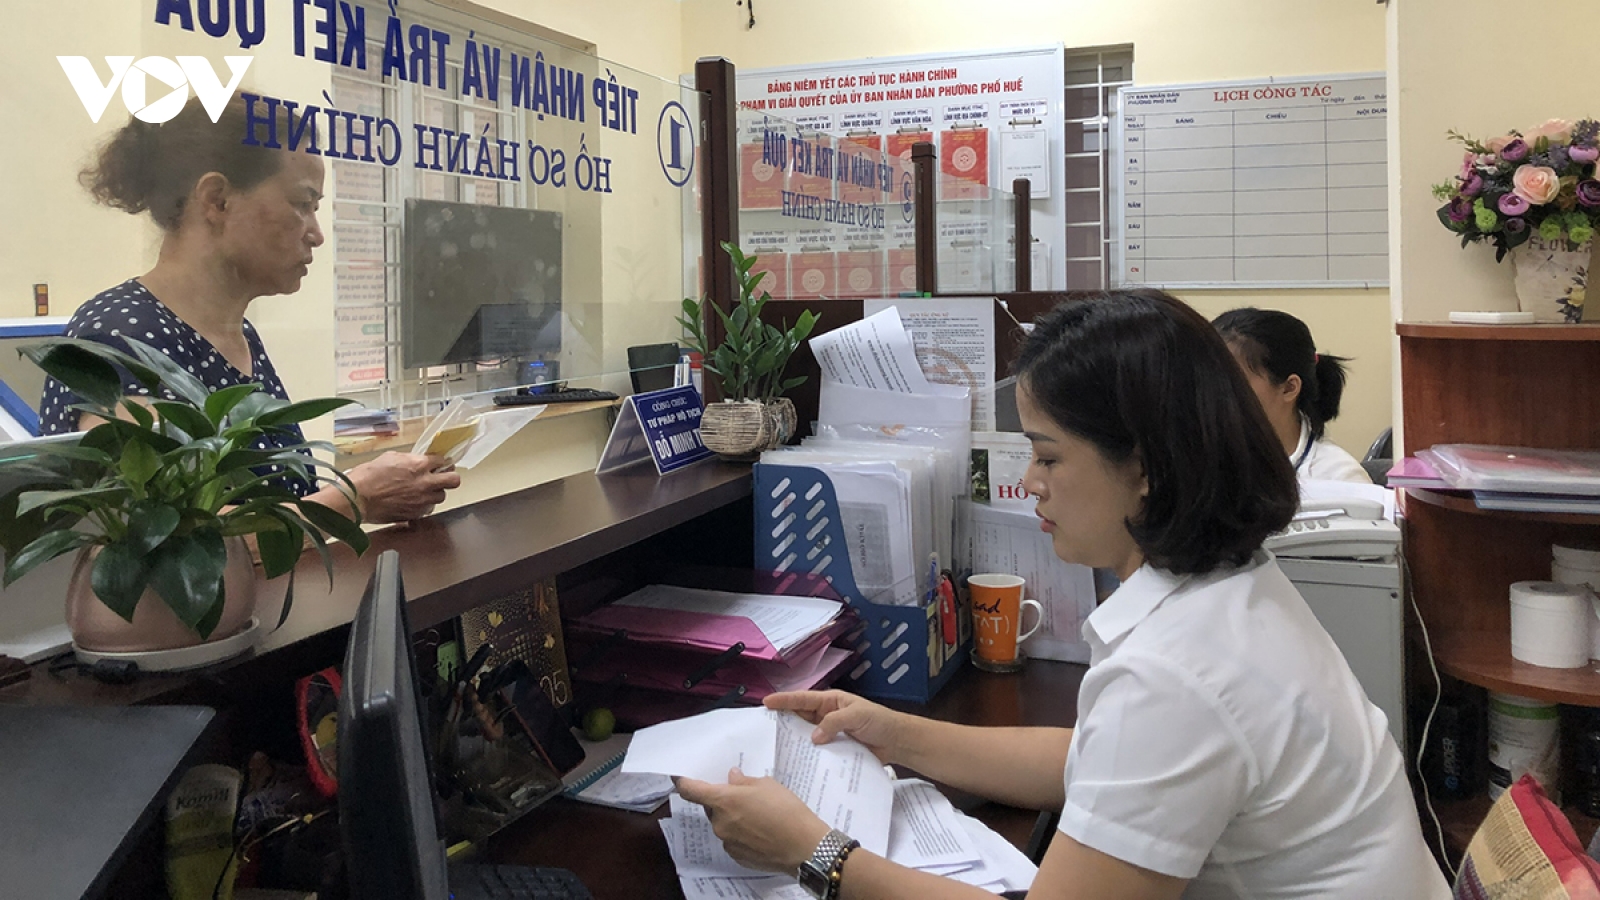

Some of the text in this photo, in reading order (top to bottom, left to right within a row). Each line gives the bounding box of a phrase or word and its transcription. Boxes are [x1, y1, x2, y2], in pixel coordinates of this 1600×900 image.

[767, 79, 791, 93] BẢNG
[819, 75, 835, 89] YẾT
[838, 74, 856, 88] CÁC
[858, 71, 876, 86] THỦ
[878, 73, 896, 87] TỤC
[899, 69, 925, 84] HÀNH
[927, 66, 957, 81] CHÍNH
[767, 98, 777, 110] VI
[779, 94, 797, 109] GIẢI
[799, 92, 827, 108] QUYẾT
[830, 92, 848, 105] CỦA
[864, 91, 884, 102] BAN
[886, 87, 913, 101] NHÂN
[915, 86, 935, 99] DÂN
[938, 82, 978, 97] PHƯỜNG
[980, 78, 1001, 93] PHỐ
[1003, 76, 1024, 92] HUẾ
[1213, 83, 1332, 103] LỊCH CÔNG TÁC
